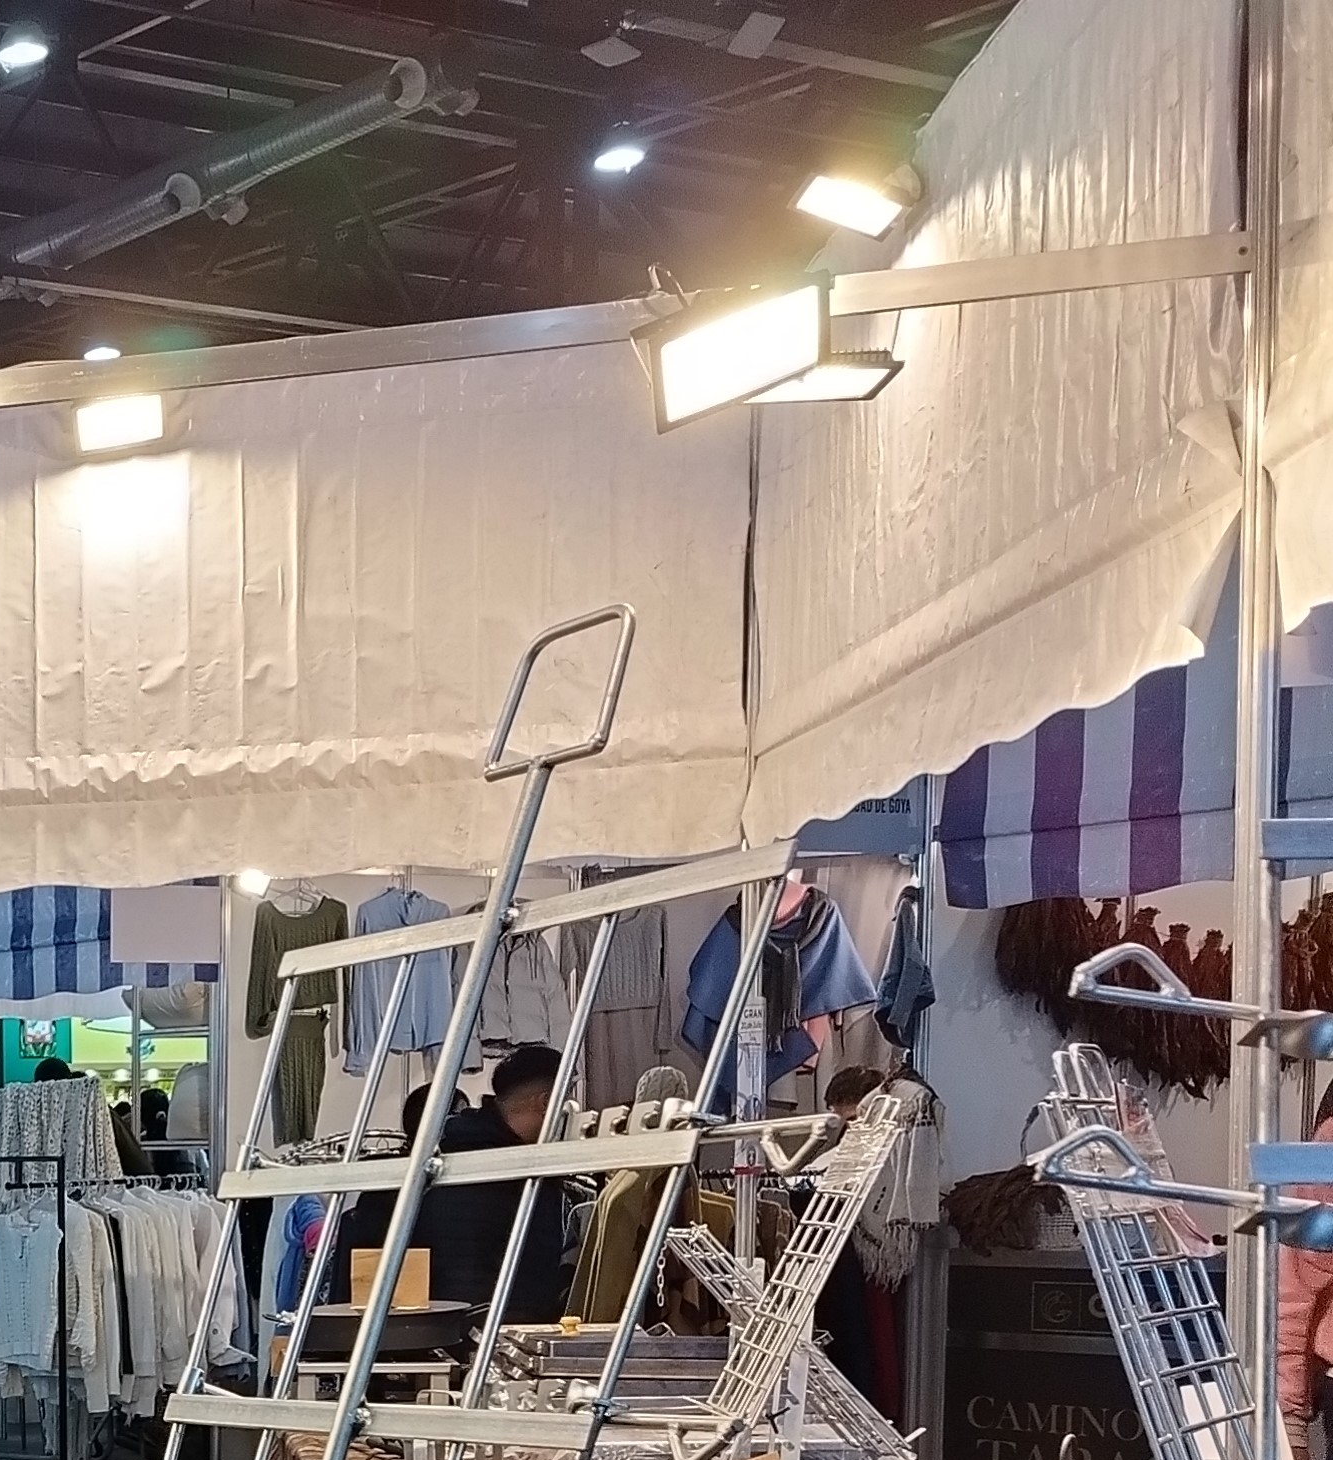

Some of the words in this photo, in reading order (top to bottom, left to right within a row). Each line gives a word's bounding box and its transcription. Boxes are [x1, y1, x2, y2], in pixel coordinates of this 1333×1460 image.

[875, 800, 886, 813] DE
[888, 799, 911, 814] GOYA
[966, 1395, 1144, 1442] CAMINO
